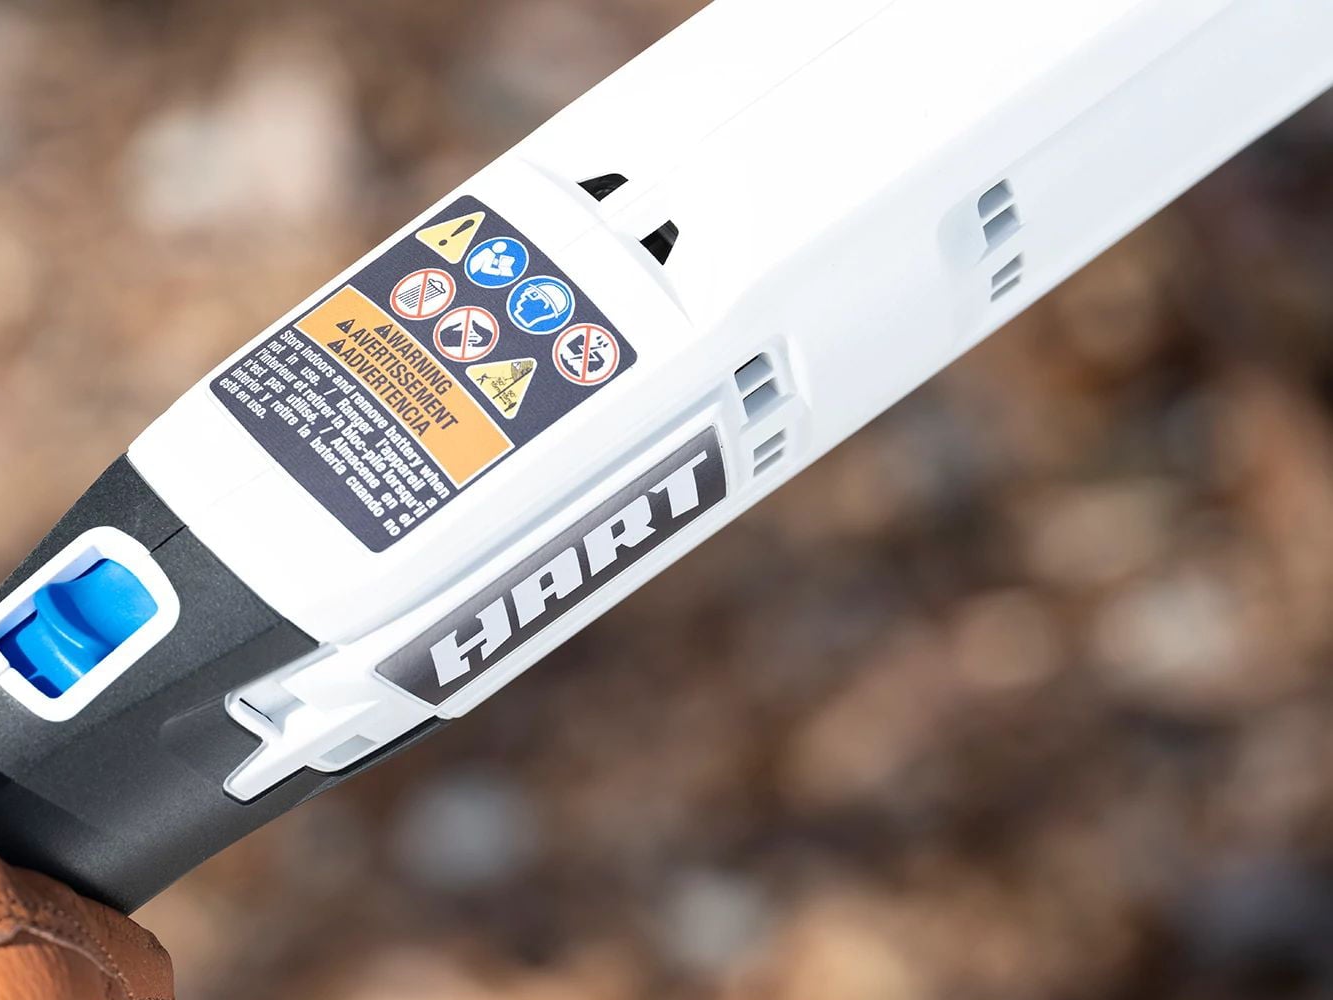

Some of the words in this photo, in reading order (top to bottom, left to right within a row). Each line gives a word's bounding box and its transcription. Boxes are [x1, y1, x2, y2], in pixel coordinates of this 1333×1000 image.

[219, 377, 242, 394] esté
[235, 390, 250, 403] en
[246, 398, 266, 419] uso.
[266, 340, 286, 354] not
[285, 352, 299, 365] in
[299, 366, 320, 386] use.
[335, 397, 374, 435] Ranger
[338, 347, 430, 436] ADVERTENCIA
[348, 328, 458, 429] AVERTISSEMENT
[386, 330, 452, 394] WARNING
[230, 366, 264, 393] interior
[258, 391, 272, 402] y
[269, 399, 298, 425] retire
[296, 423, 311, 438] la
[309, 435, 346, 475] batería
[345, 475, 384, 517] cuando
[382, 518, 400, 536] no
[262, 376, 285, 393] pas
[285, 393, 319, 425] utilisé.
[329, 436, 380, 488] Almacene
[380, 492, 398, 509] en
[398, 512, 415, 527] el
[279, 329, 304, 354] Store
[300, 345, 336, 377] indoors
[331, 374, 356, 394] and
[349, 391, 388, 428] remove
[383, 424, 424, 467] battery
[419, 464, 450, 499] when
[292, 380, 308, 392] et
[302, 388, 336, 418] retirer
[330, 413, 345, 429] la
[340, 423, 386, 472] bloc-pile
[429, 450, 708, 688] HART
